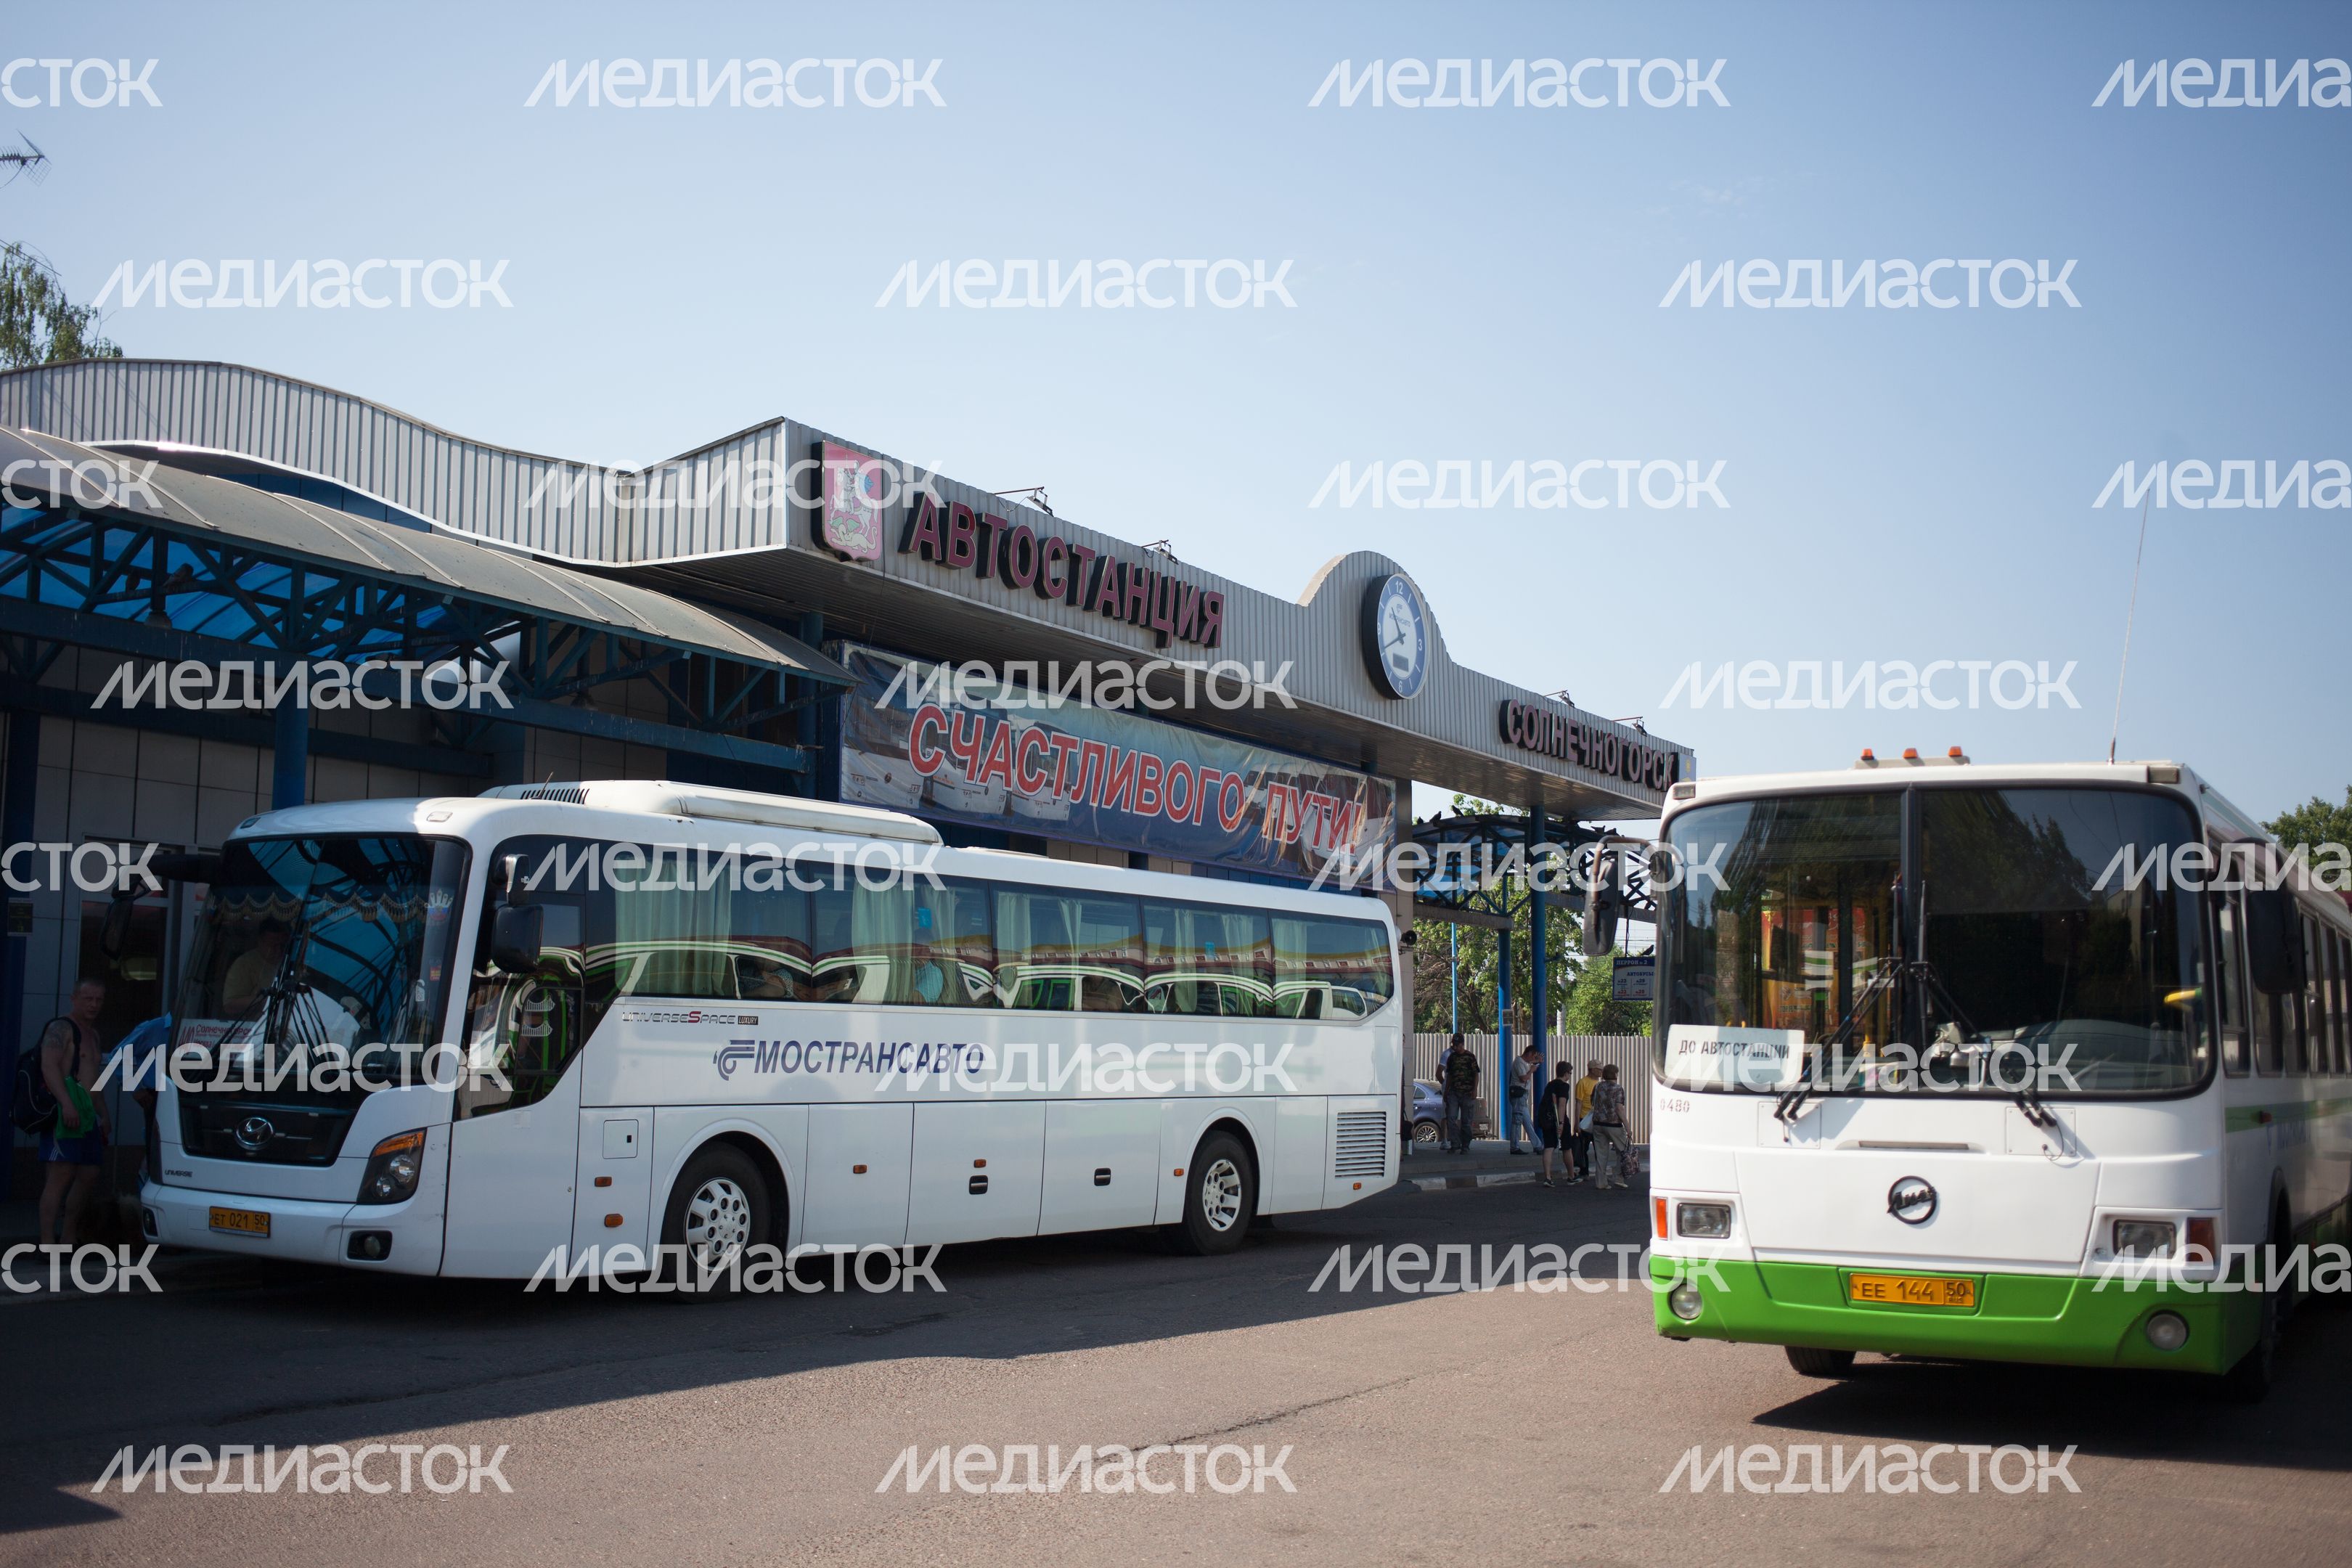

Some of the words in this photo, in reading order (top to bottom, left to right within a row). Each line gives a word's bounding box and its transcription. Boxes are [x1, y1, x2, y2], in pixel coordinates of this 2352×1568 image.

[909, 491, 1225, 648] АВТОСТАНЦИЯ
[1395, 580, 1404, 595] 12
[1418, 638, 1423, 651] 3
[1398, 681, 1403, 693] 6
[1507, 698, 1675, 791] СОЛНЕЧНОГОРСК
[908, 703, 1244, 834] СЧАСТЛИВОГО
[1262, 780, 1363, 857] ПУТИ!
[738, 1016, 759, 1025] LUXURY
[754, 1040, 986, 1074] МОСТРАНСАВТО
[1678, 1040, 1696, 1055] ДО
[1701, 1040, 1790, 1059] АВТОСТАНЦИИ
[1659, 1098, 1691, 1113] 0480
[229, 1212, 248, 1228] 021
[254, 1214, 265, 1226] 50
[1895, 1280, 1934, 1301] 144
[1945, 1282, 1967, 1297] 50
